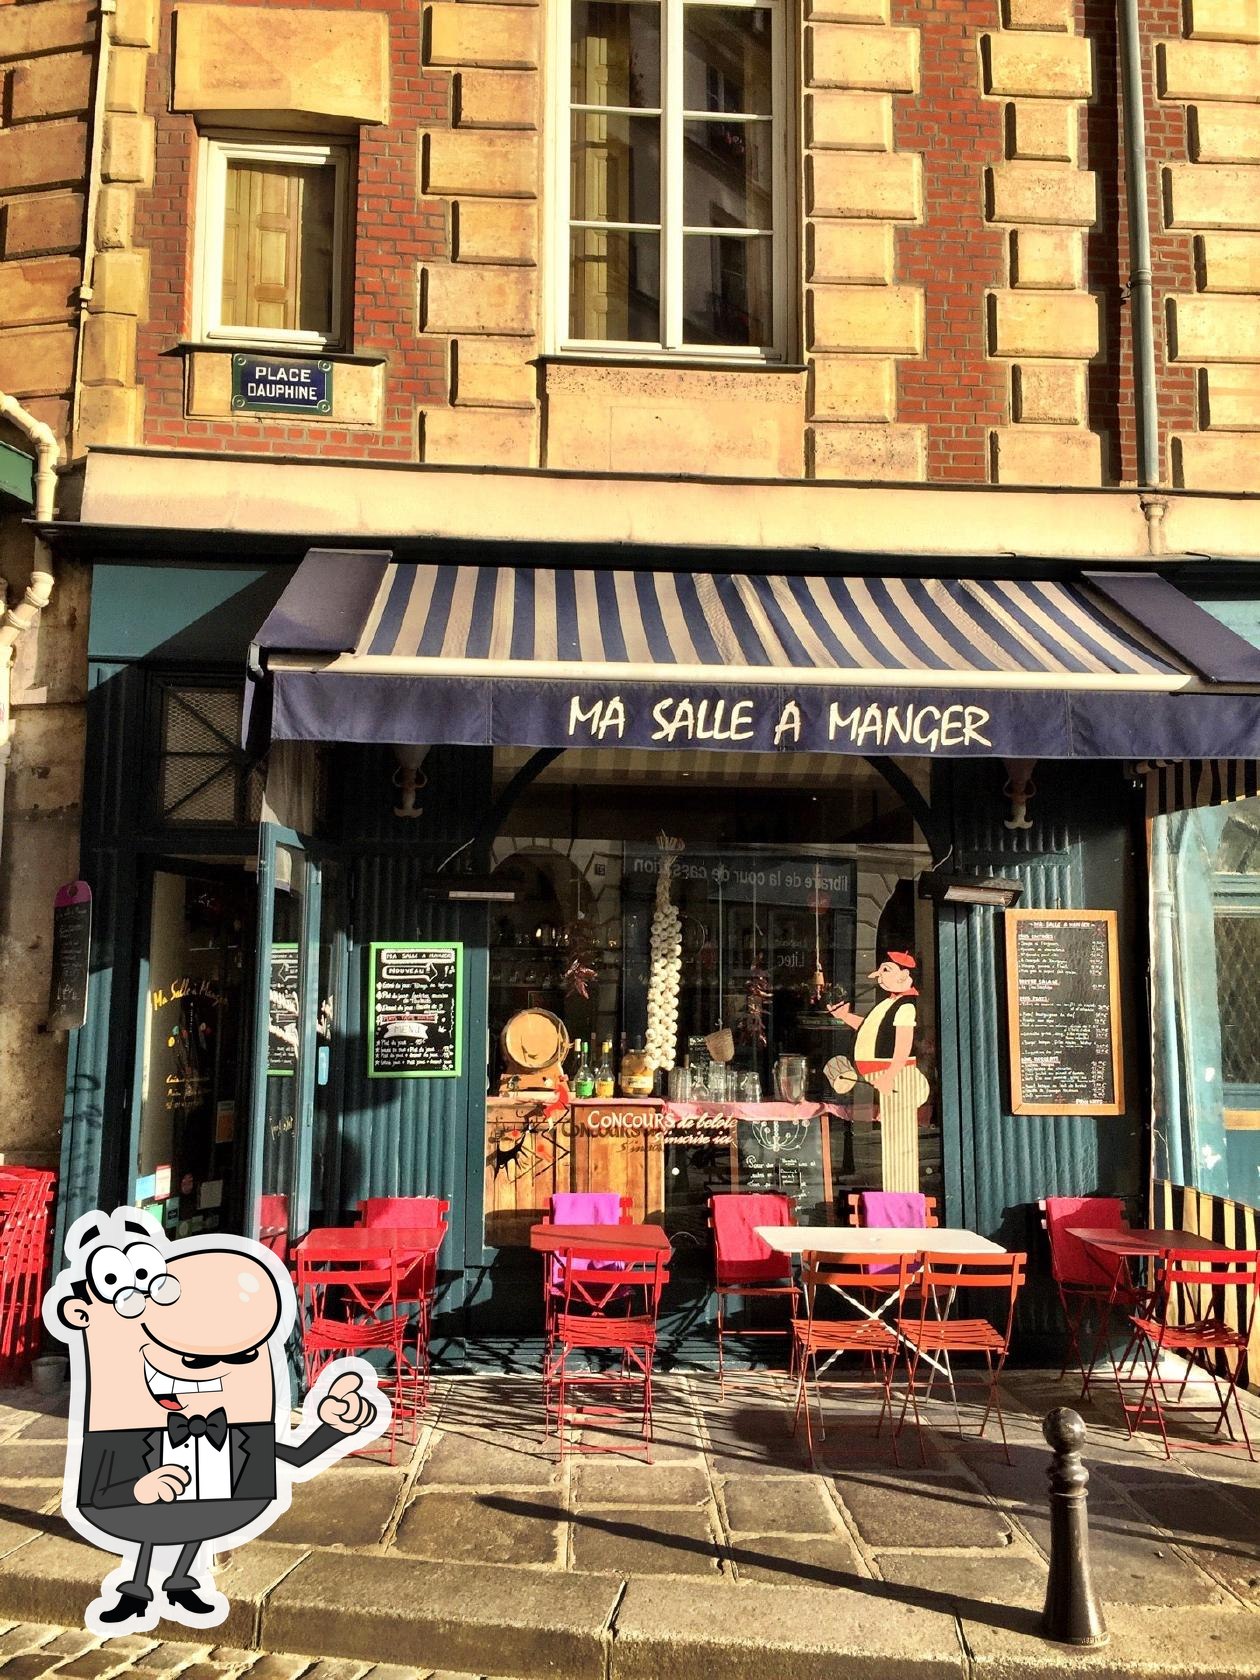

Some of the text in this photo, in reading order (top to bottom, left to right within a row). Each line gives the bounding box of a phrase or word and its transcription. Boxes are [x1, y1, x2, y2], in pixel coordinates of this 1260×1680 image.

[255, 366, 311, 382] PLACE
[247, 382, 318, 400] DAUPHINE
[568, 695, 992, 752] MA SALLE A MANGER
[153, 989, 168, 1011] Ma
[170, 978, 191, 1001] Salle
[677, 1115, 694, 1128] de
[696, 1112, 738, 1129] belote
